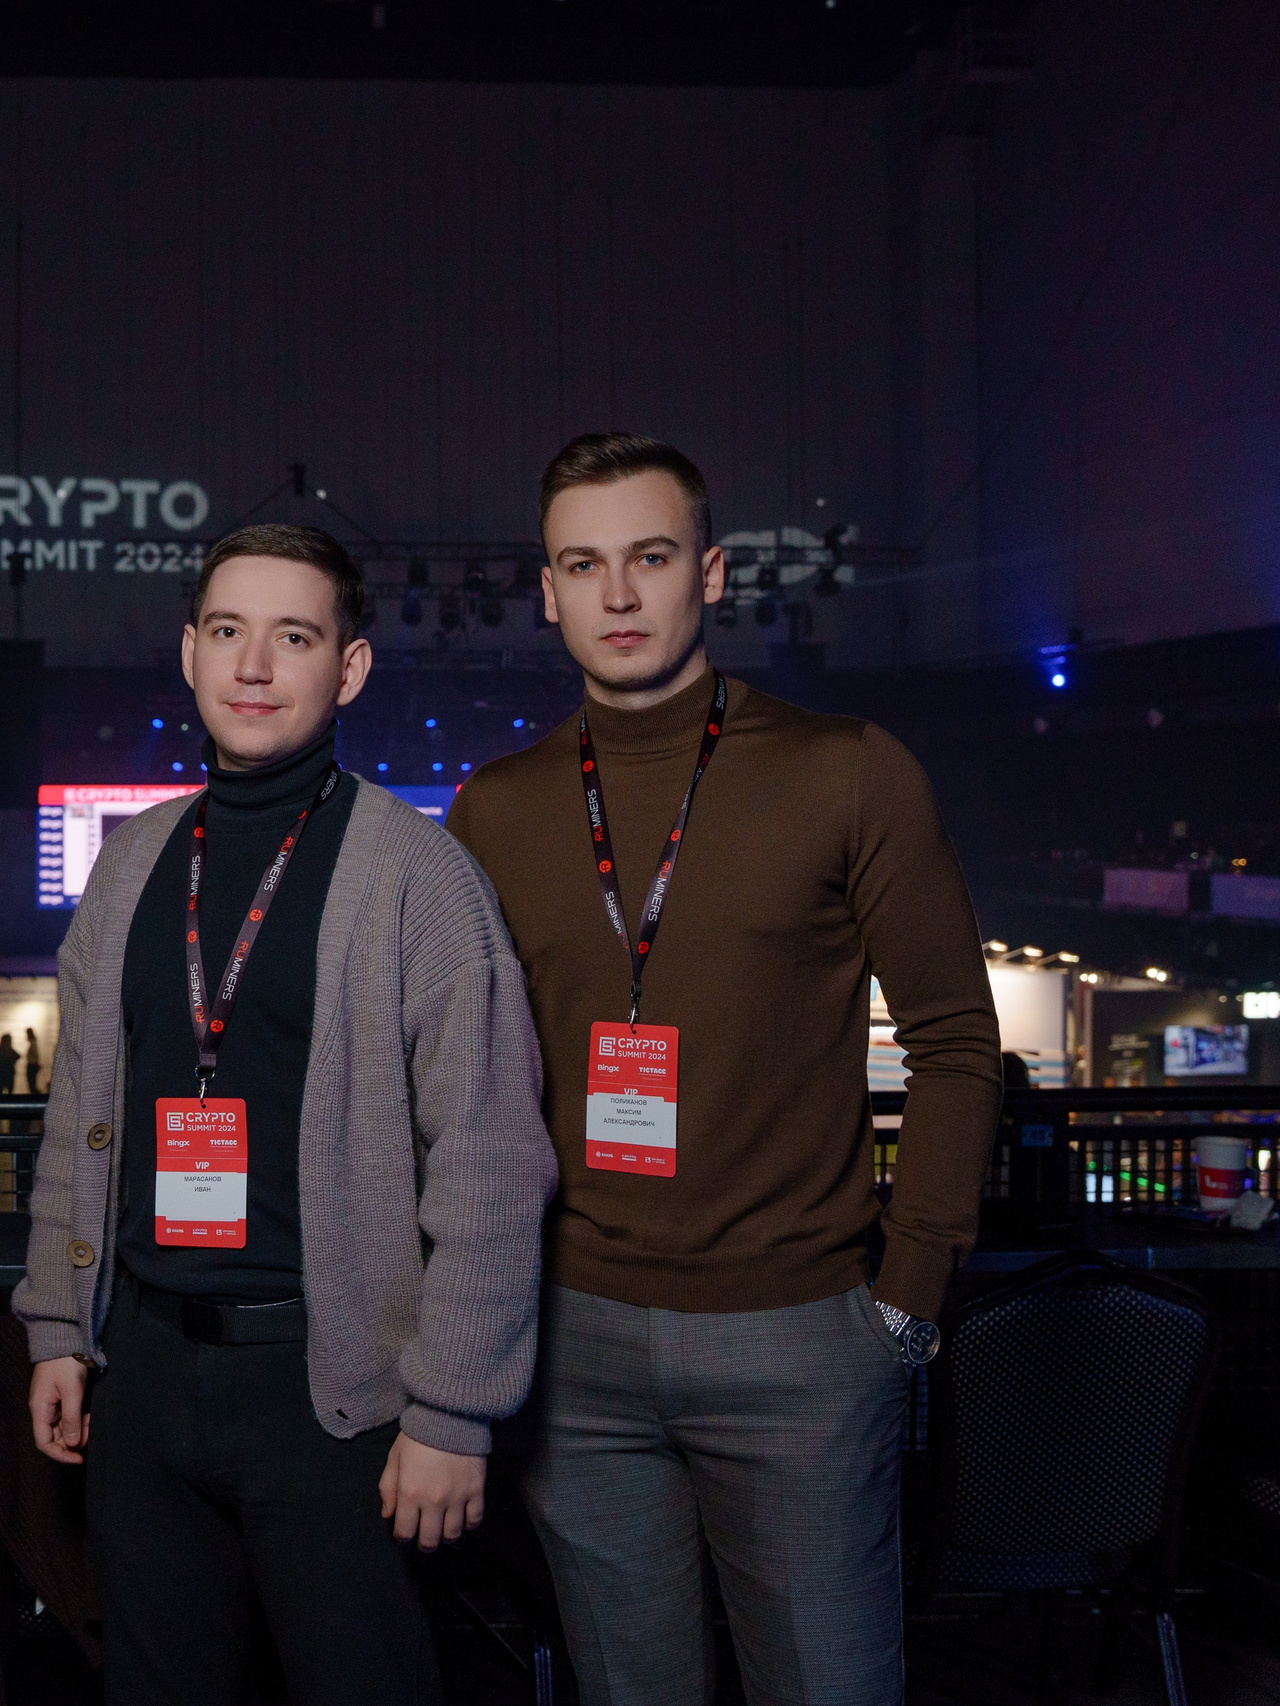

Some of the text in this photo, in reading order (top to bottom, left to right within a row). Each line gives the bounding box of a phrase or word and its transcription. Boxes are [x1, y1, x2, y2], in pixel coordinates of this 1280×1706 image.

[114, 541, 205, 573] 2024
[588, 788, 604, 842] RUMINERS
[264, 835, 294, 892] RUMINERS
[188, 855, 201, 911] RUMINERS
[647, 860, 670, 922] RUMINERS
[222, 940, 249, 1001] RUMINERS
[190, 962, 205, 1024] RUMINERS
[617, 1038, 667, 1051] CRYPTO
[617, 1050, 646, 1059] SUMMIT
[610, 1098, 647, 1106] ПОЛИКАНОВ
[616, 1108, 641, 1116] МАКСИМ
[186, 1112, 236, 1123] CRYPTO
[603, 1118, 655, 1127] АЛЕКСАНДРОВИЧ
[195, 1161, 209, 1169] VIP
